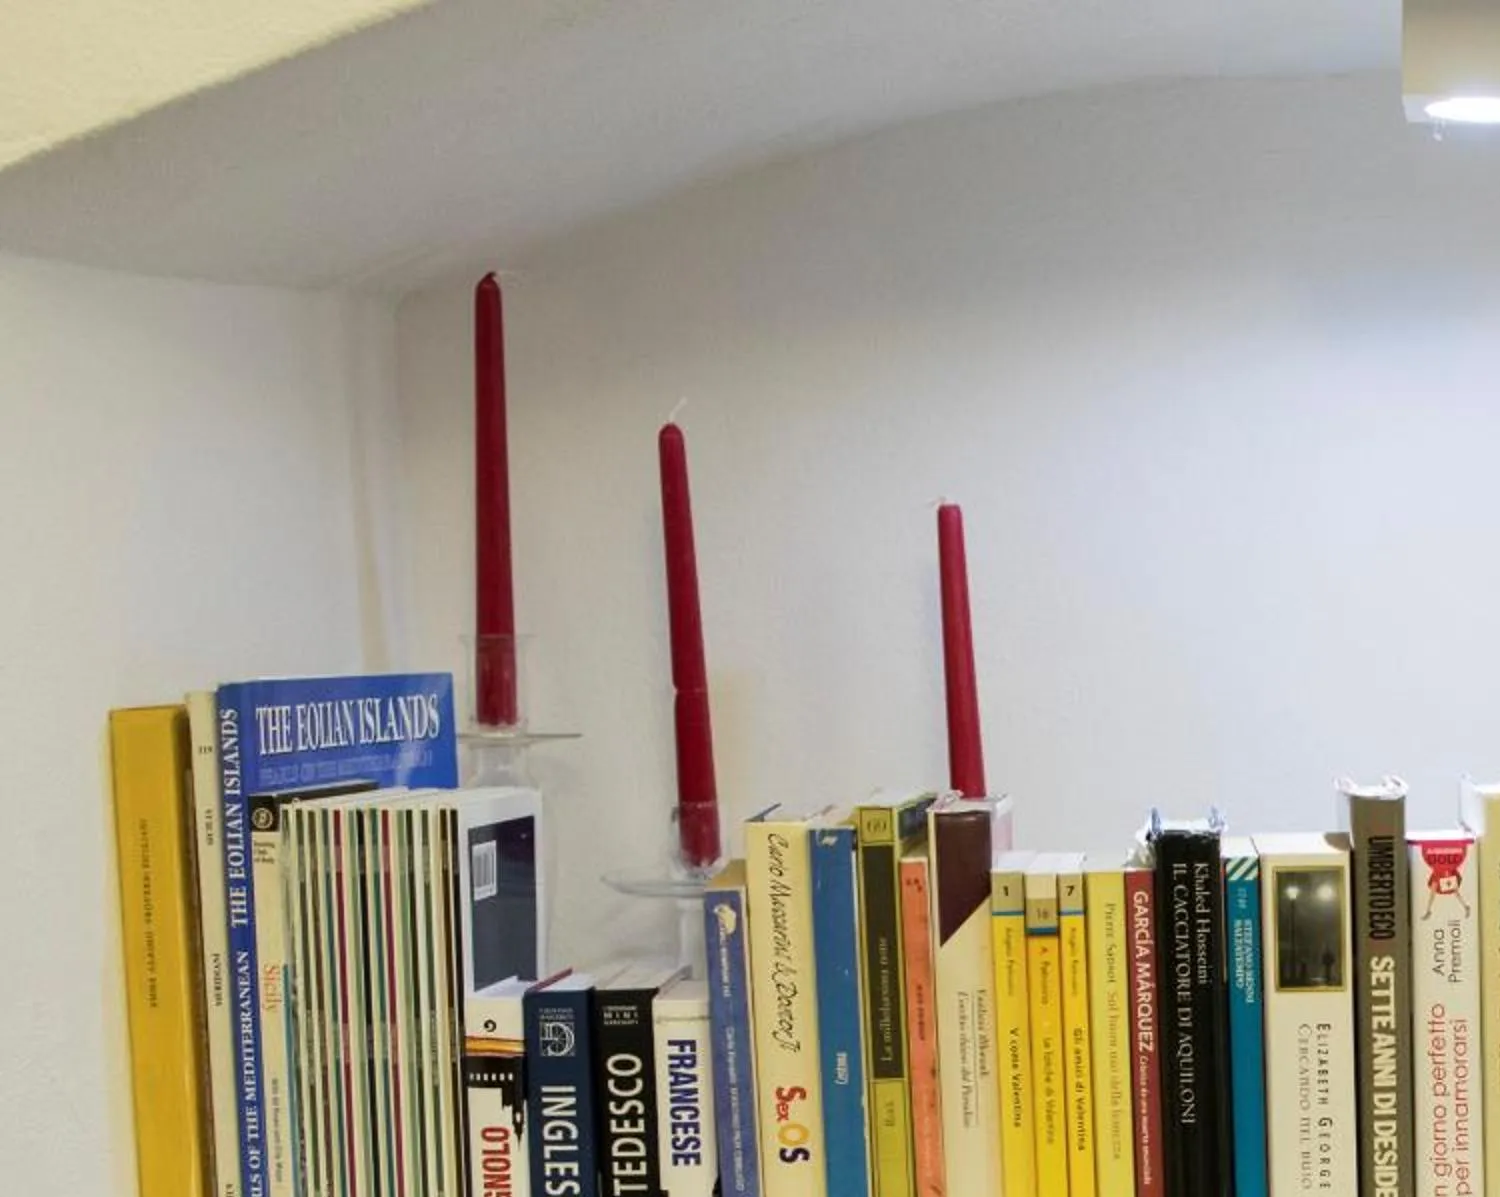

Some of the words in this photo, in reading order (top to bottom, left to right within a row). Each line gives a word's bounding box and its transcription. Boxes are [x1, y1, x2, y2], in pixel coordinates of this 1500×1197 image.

[220, 709, 241, 795] ISLANDS
[255, 705, 292, 755] THE
[296, 700, 355, 751] EOLIAN
[358, 694, 440, 744] ISLANDS
[225, 803, 246, 880] EOLIAN
[1174, 863, 1188, 881] IL
[1368, 835, 1395, 908] UMBERTO
[230, 889, 249, 928] THE
[1194, 863, 1211, 912] Khaled
[1134, 890, 1154, 958] GARCÍA
[1174, 885, 1192, 1001] CACCIATORE
[1197, 918, 1213, 984] Hosseini
[1369, 909, 1396, 940] ECO
[1431, 929, 1445, 976] Anna
[1447, 920, 1463, 983] Premoli
[236, 951, 259, 1101] MEDITERRANEAN
[1135, 962, 1155, 1052] MÁRQUEZ
[1178, 1007, 1194, 1028] DI
[1371, 956, 1395, 1030] SETTE
[1178, 1031, 1196, 1124] AQUILONI
[1317, 1023, 1332, 1105] ELIZABETH
[1372, 1033, 1398, 1087] ANNI
[1426, 1004, 1450, 1097] perfetto
[667, 1039, 702, 1167] FRANCESE
[1373, 1091, 1398, 1114] DI
[1450, 1019, 1469, 1153] innamorarsi
[244, 1106, 260, 1142] THE
[248, 1147, 262, 1168] OF
[606, 1053, 648, 1197] TEDESCO
[1318, 1116, 1333, 1189] GEORGE
[1428, 1106, 1453, 1177] giorno
[1454, 1157, 1472, 1196] per
